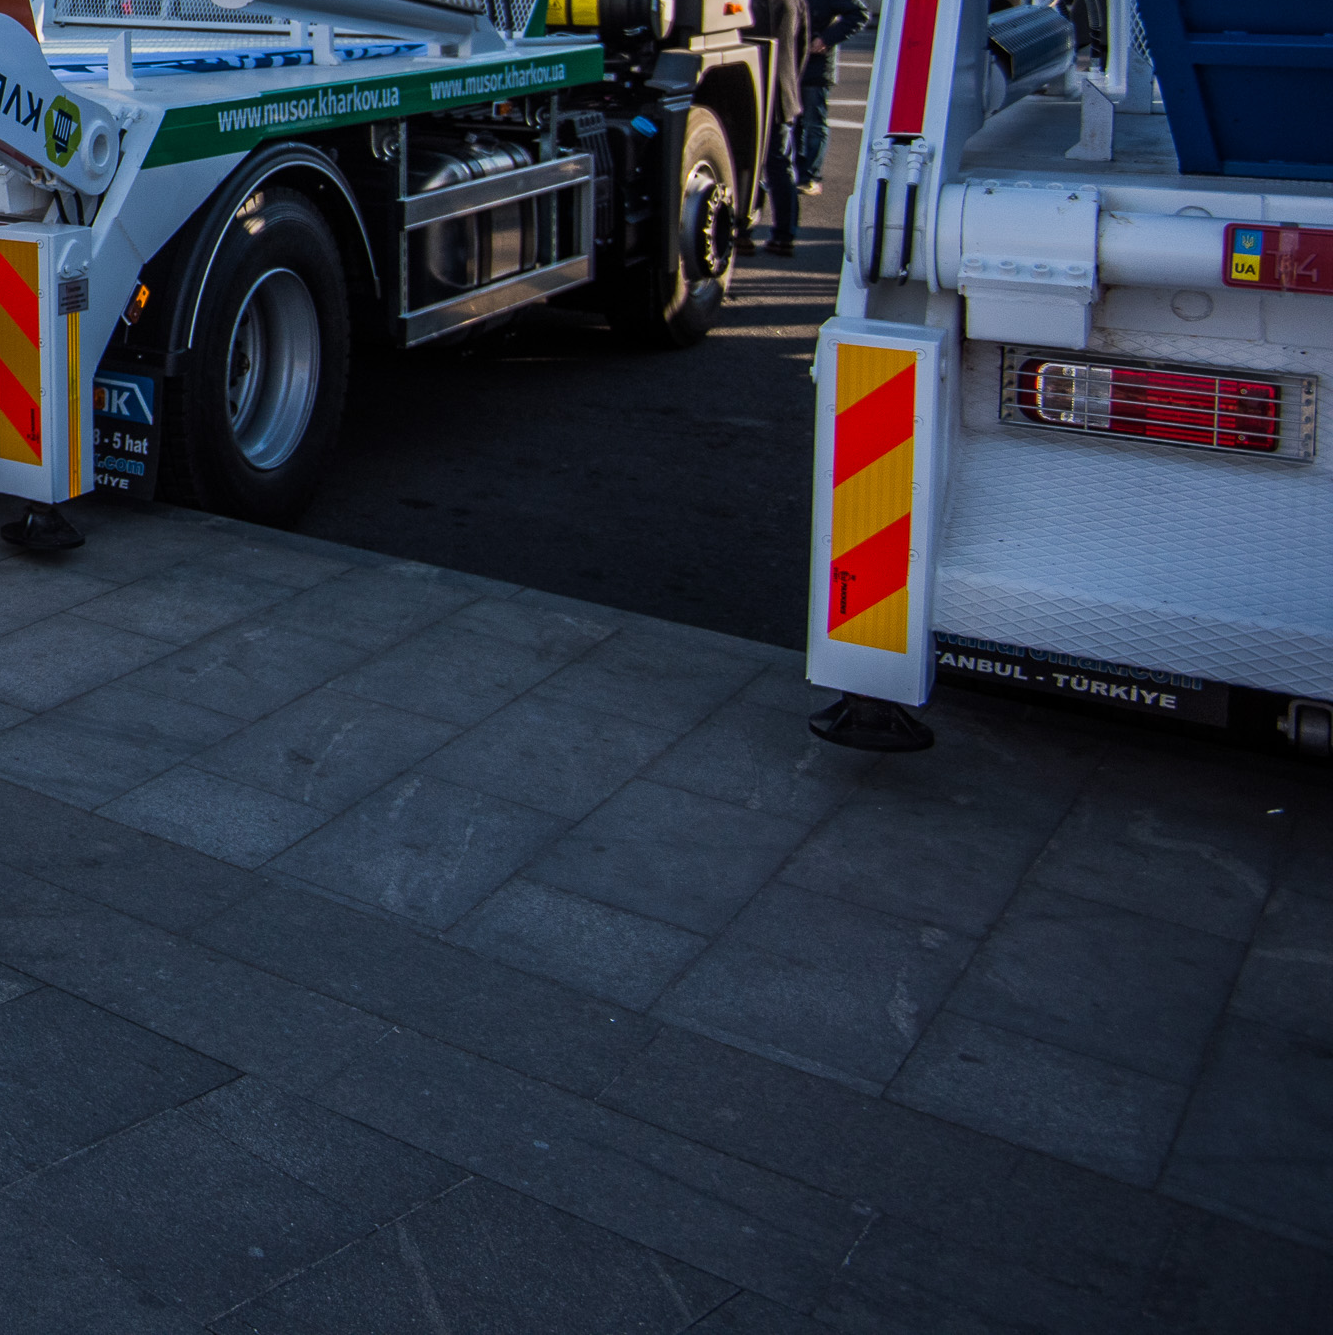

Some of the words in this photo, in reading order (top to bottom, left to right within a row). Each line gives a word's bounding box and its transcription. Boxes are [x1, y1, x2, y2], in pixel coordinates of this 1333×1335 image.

[430, 63, 565, 100] www.musor.kharkov.ua
[218, 85, 400, 132] www.musor.kharkov.ua
[1234, 263, 1256, 275] UA
[124, 434, 149, 455] hat
[1052, 673, 1178, 709] TÜRKİYE
